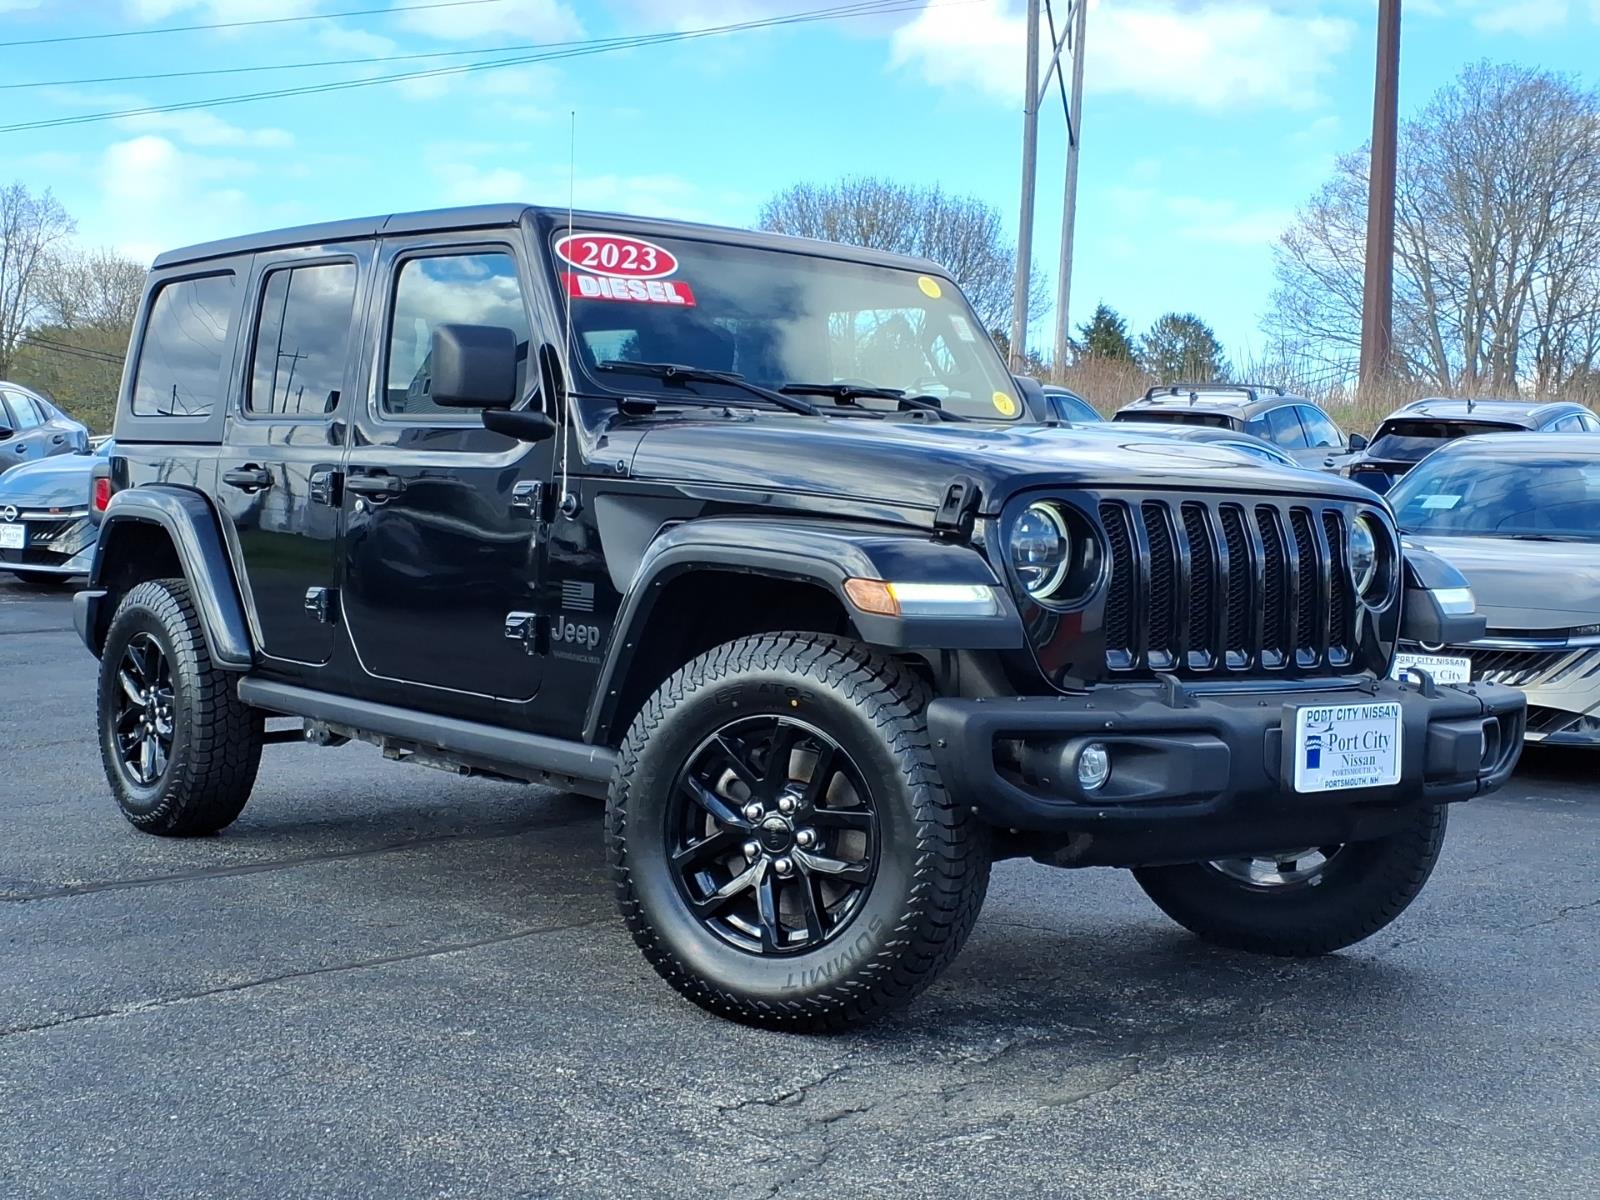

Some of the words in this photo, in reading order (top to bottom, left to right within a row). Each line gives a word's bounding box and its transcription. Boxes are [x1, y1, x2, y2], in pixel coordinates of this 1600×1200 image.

[581, 241, 657, 271] 2023
[576, 275, 685, 304] DIESEL
[551, 615, 600, 651] Jeep
[1417, 656, 1434, 664] CITY
[1437, 658, 1466, 667] NISSAN
[1440, 669, 1461, 681] City
[1307, 709, 1333, 722] PORT
[1336, 707, 1359, 721] CITY
[1361, 704, 1398, 719] NISSAN
[1328, 733, 1358, 752] Port
[1363, 730, 1391, 754] City
[1342, 754, 1376, 767] Nissan
[779, 913, 882, 989] SUMMIT
